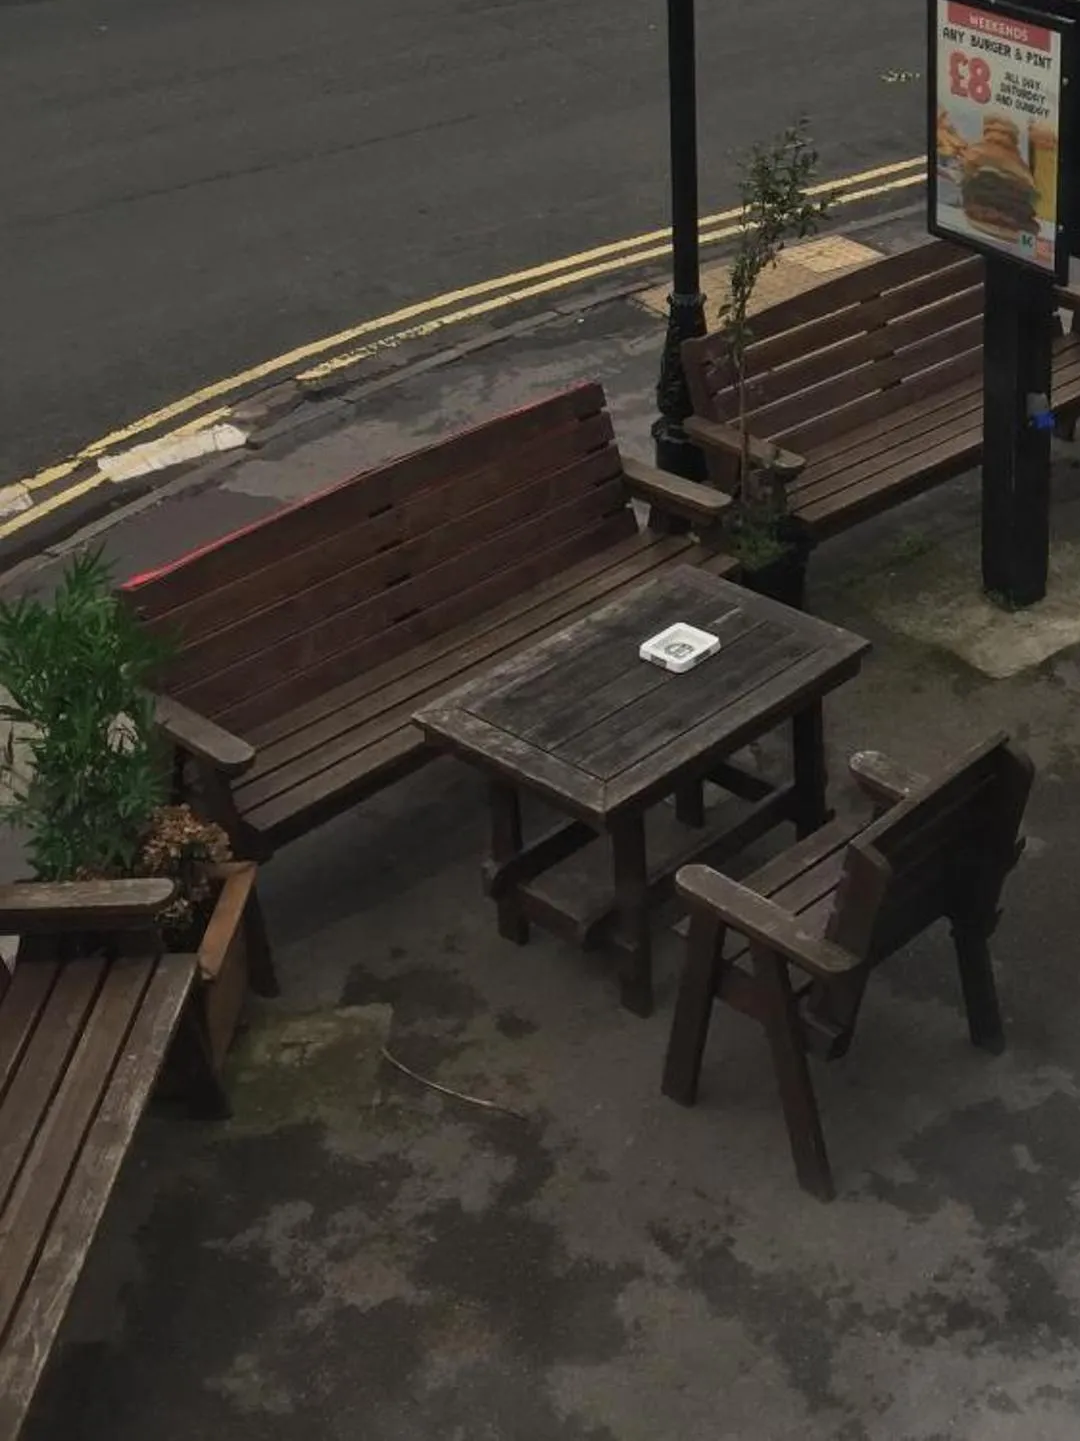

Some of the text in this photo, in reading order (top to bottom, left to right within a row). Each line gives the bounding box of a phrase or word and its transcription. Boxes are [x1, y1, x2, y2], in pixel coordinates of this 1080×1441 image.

[943, 26, 1053, 70] ANY BURGER & PINT
[969, 14, 1029, 42] WEEKENDS
[949, 49, 991, 104] £8
